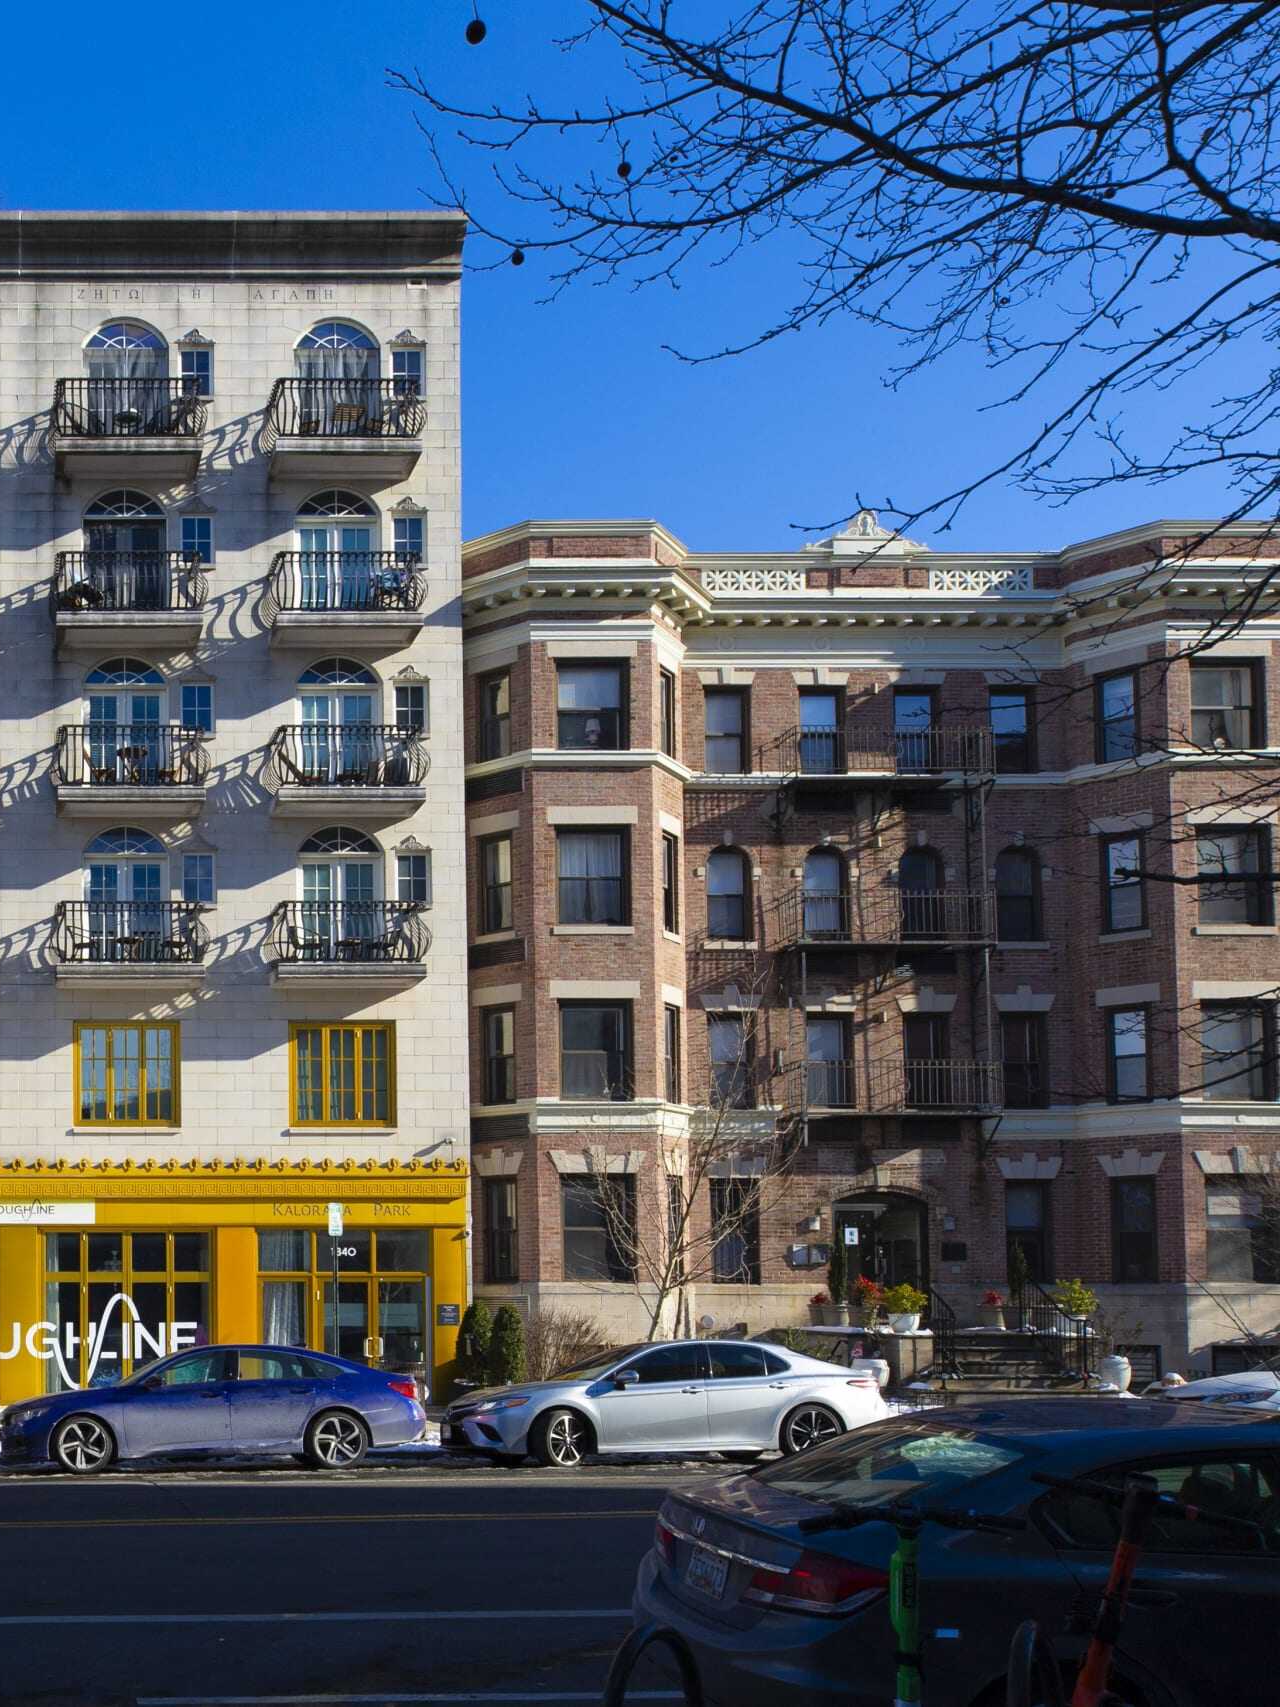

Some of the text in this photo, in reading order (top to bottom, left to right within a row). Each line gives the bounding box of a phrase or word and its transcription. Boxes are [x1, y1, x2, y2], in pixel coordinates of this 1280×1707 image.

[76, 288, 141, 299] ΖΗΤΩ
[253, 288, 334, 300] ΑΓΑΠΗ
[272, 1202, 411, 1216] KALORAA PARK
